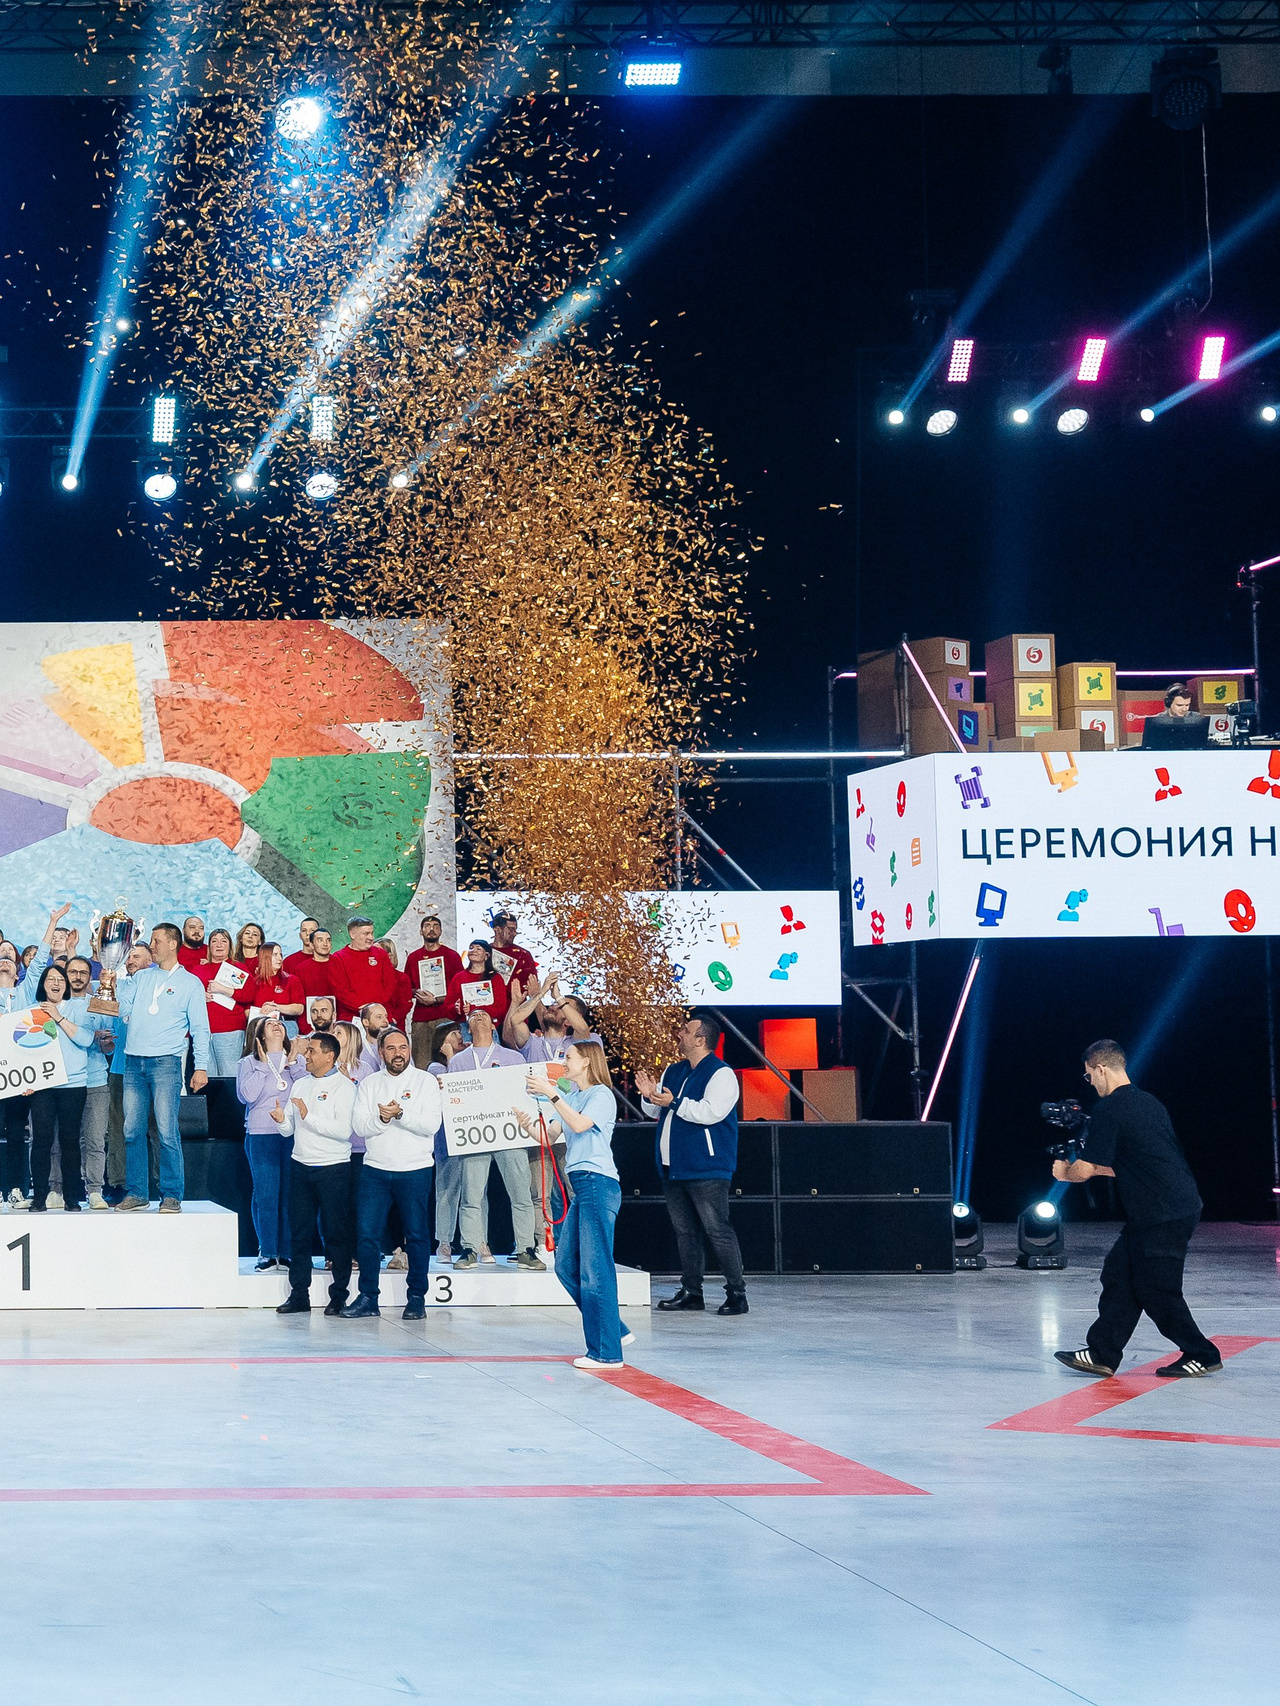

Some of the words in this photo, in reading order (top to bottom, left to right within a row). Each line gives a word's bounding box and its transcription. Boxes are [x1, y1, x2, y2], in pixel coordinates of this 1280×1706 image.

[962, 826, 1233, 865] ЦЕРЕМОНИЯ
[1250, 826, 1276, 856] Н
[447, 1078, 481, 1088] КОМАНДА
[448, 1085, 484, 1094] МАСТЕРОВ
[452, 1111, 505, 1124] сертификат
[454, 1125, 496, 1147] 300
[6, 1232, 31, 1291] 1
[435, 1275, 453, 1303] 3
